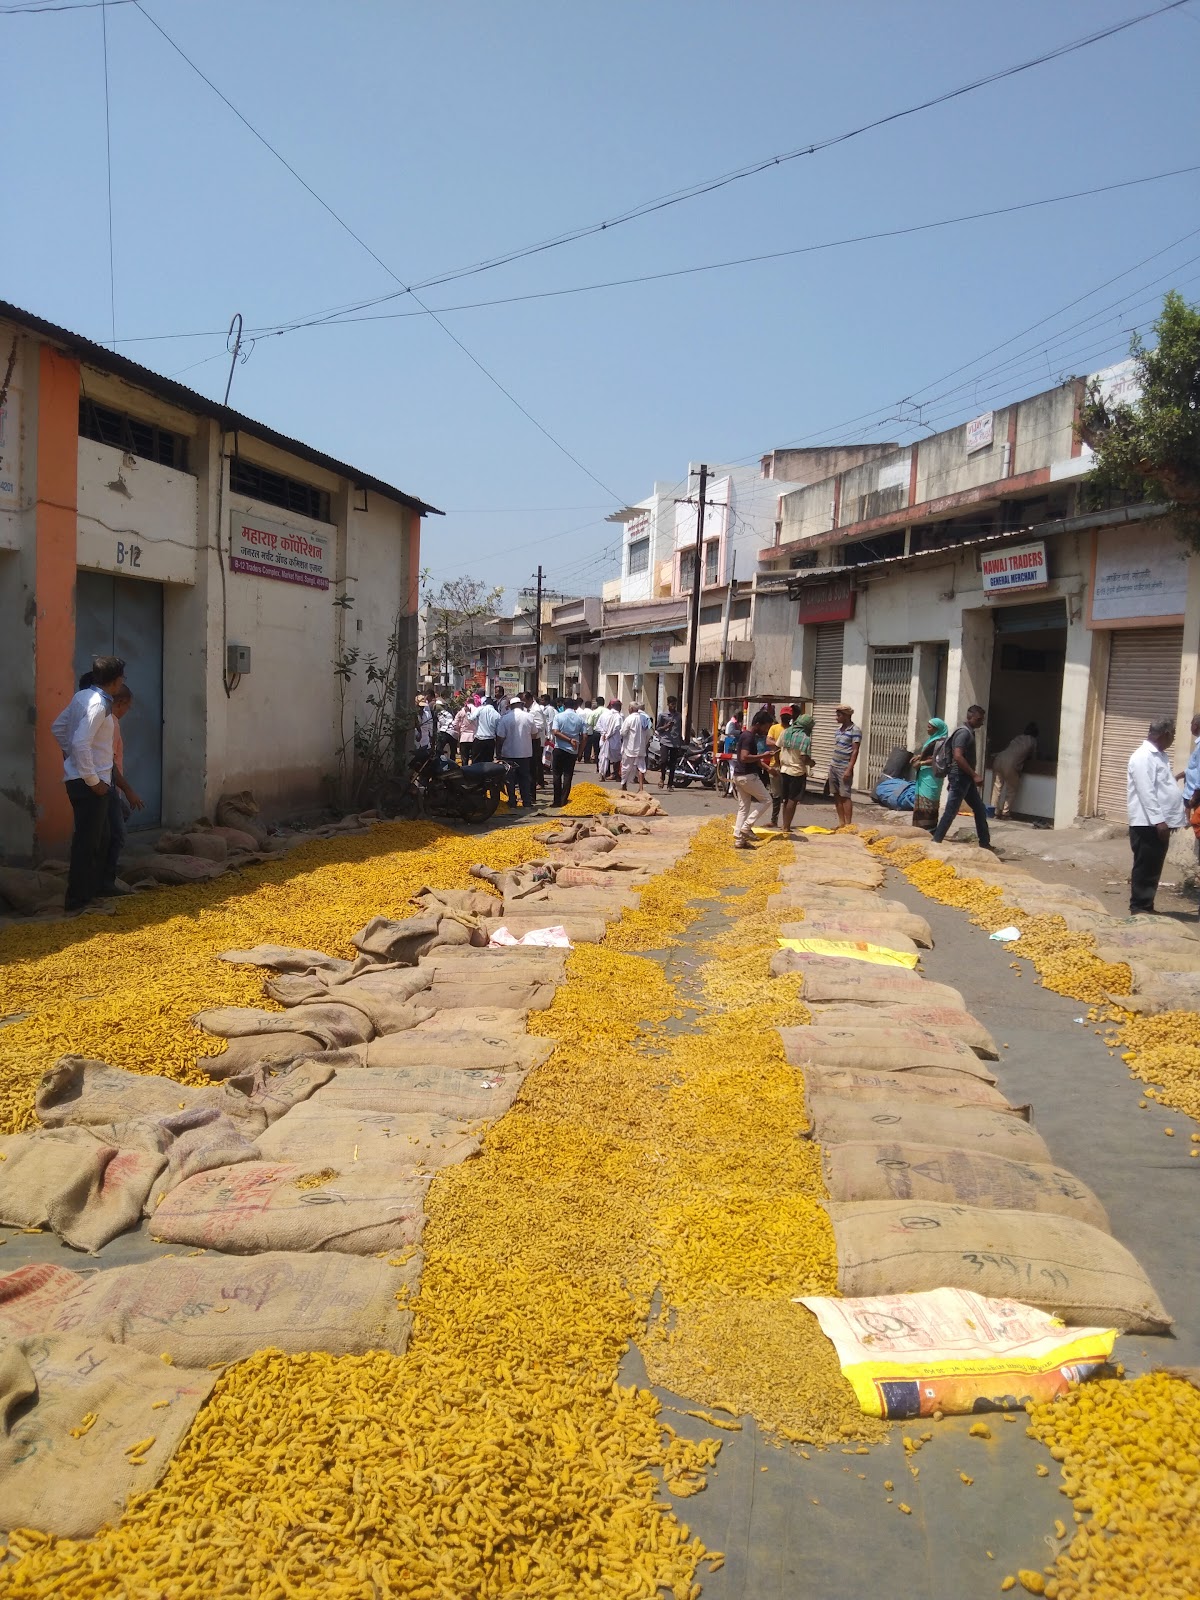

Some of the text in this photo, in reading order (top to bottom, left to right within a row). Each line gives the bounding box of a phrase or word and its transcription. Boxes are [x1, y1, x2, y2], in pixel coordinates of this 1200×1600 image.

[116, 541, 143, 567] B-12
[241, 526, 323, 560] महाराष्ट्र कॉर्पोरेशन
[234, 559, 246, 569] B-12
[983, 551, 1043, 575] NAWAJ TRADERS
[990, 570, 1037, 586] GENERAL MERCHANT
